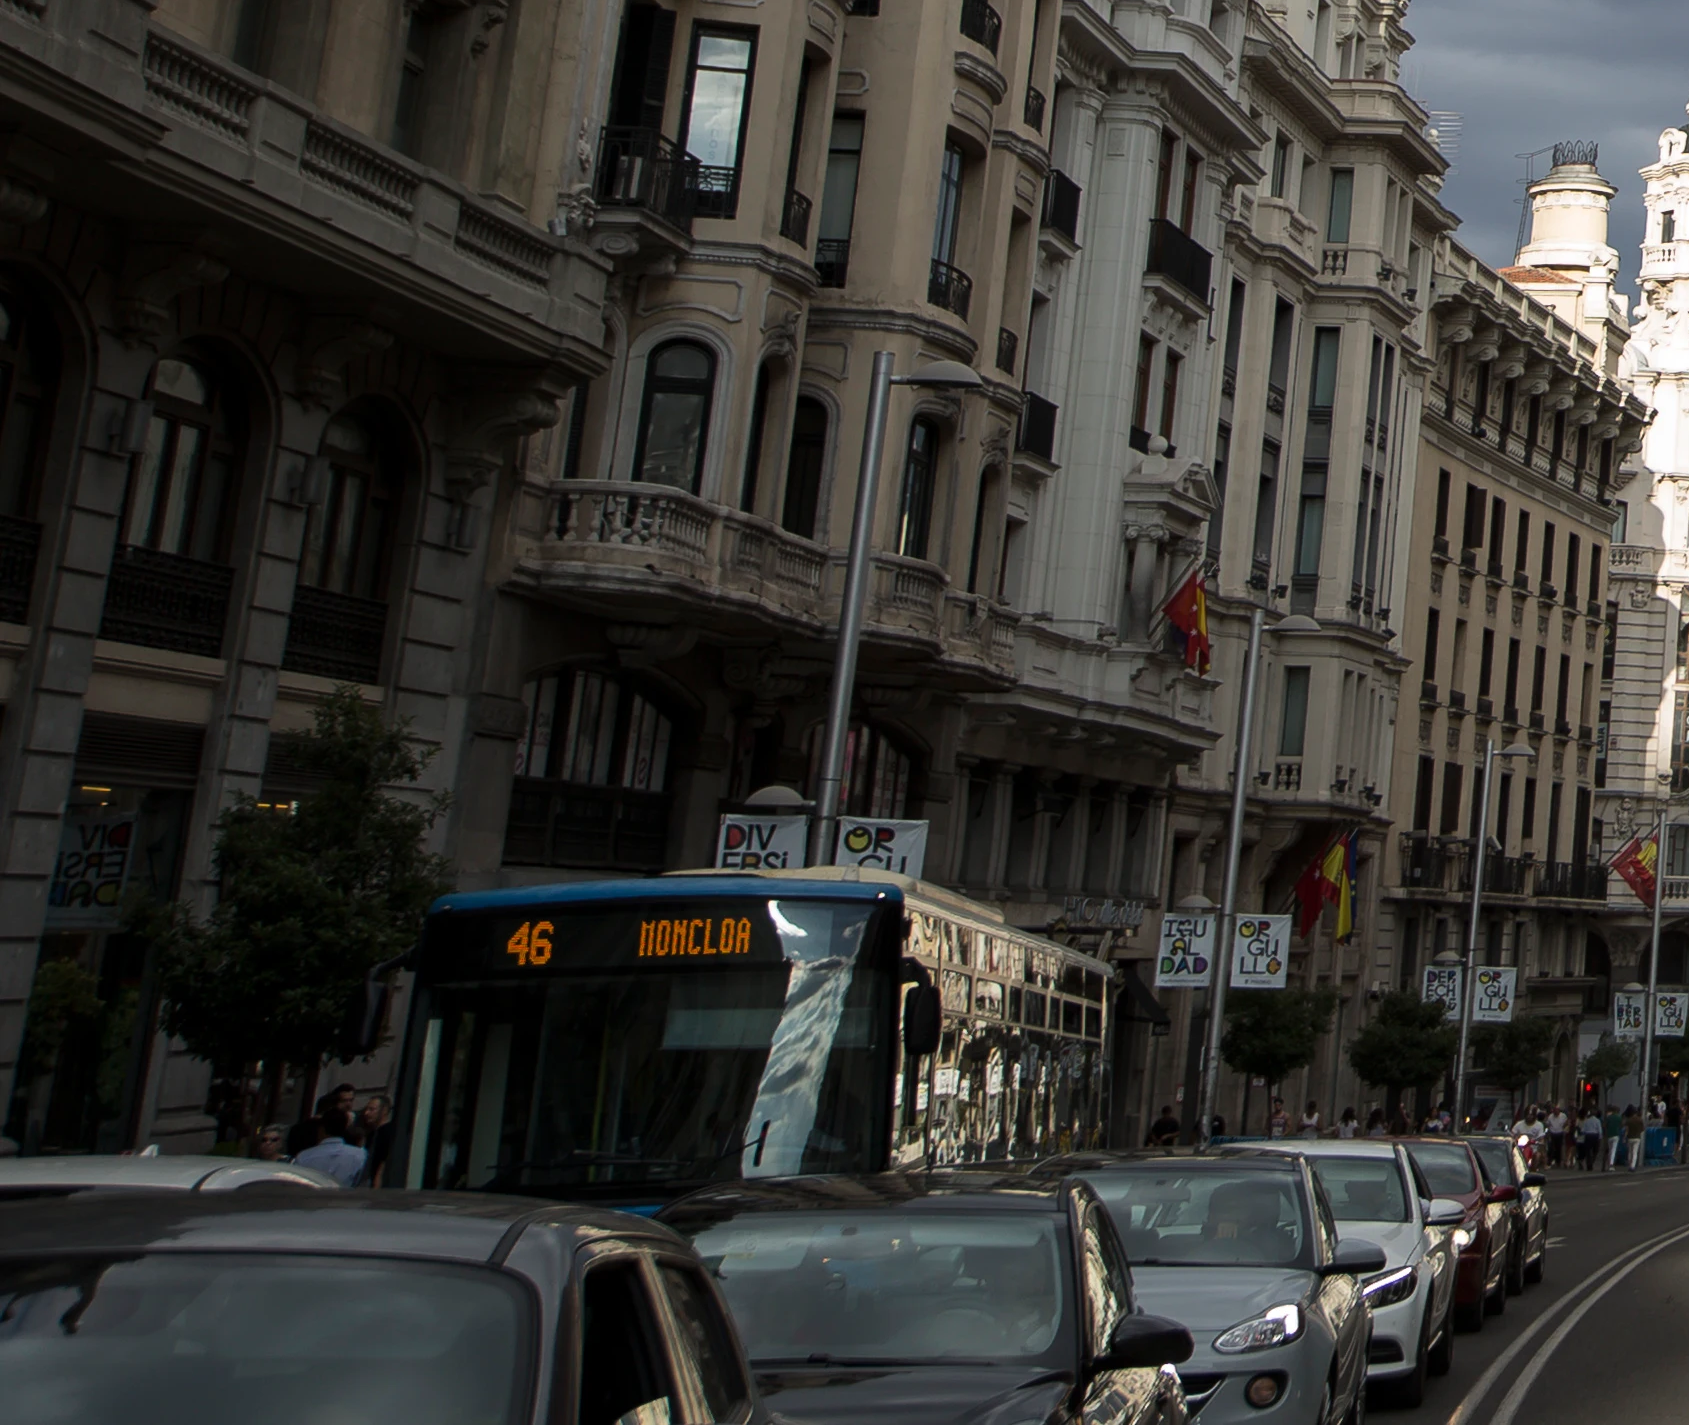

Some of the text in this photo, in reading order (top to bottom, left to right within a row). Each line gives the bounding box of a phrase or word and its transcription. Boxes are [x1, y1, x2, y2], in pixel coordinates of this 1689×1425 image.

[724, 823, 777, 850] DIV
[844, 826, 896, 853] OR
[1163, 919, 1208, 938] IGU
[1238, 920, 1272, 938] OR
[506, 917, 752, 966] 46 MONCLOA
[1247, 938, 1279, 957] GU
[1159, 956, 1208, 975] DAD
[1239, 957, 1281, 976] LLO
[1478, 970, 1502, 984] OR
[1484, 984, 1508, 998] GU
[1479, 997, 1509, 1011] LLO
